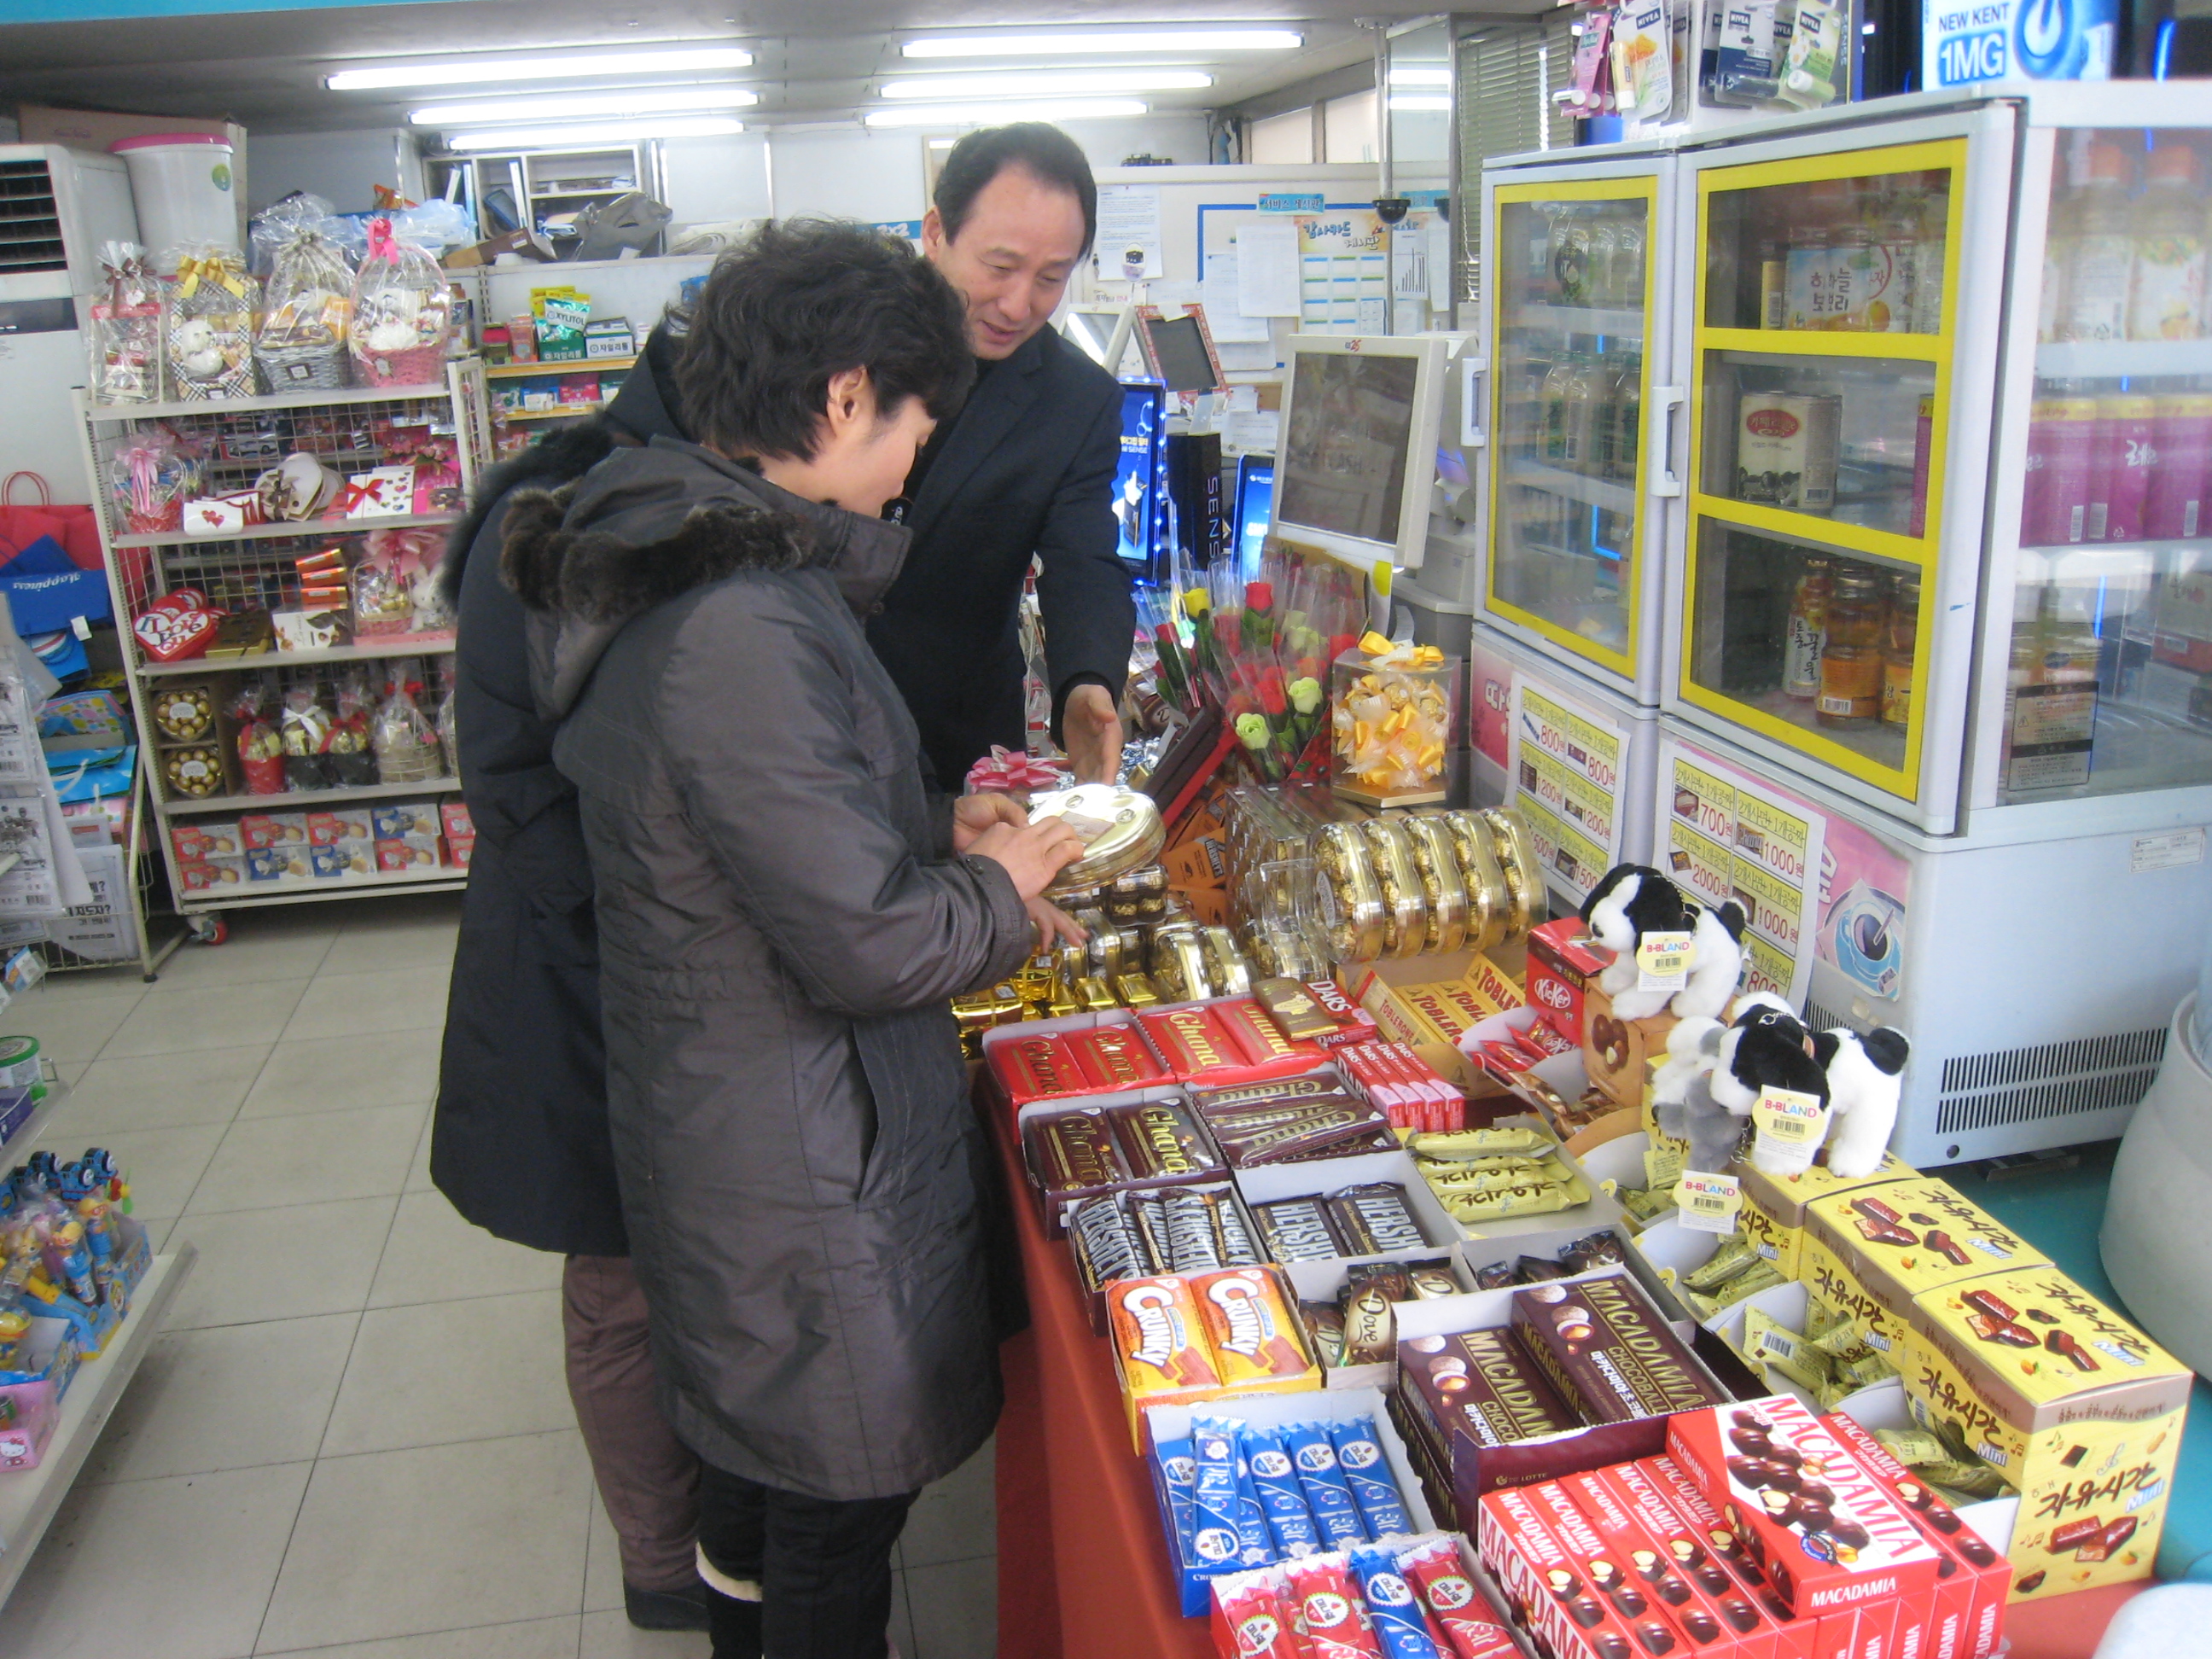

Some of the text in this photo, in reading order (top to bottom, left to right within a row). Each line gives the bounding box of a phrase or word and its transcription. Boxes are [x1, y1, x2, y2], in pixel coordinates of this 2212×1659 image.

[1637, 9, 1661, 28] NIVEA
[1730, 12, 1749, 25] NIVEA
[1800, 14, 1820, 32] NIVEA
[1939, 3, 2010, 32] NEW KENT
[1941, 32, 2004, 82] 1MG
[556, 311, 586, 325] XYLITOL
[599, 342, 629, 352] 자일리톨
[1700, 803, 1733, 837] 700원
[1764, 841, 1804, 879] 1000원
[1692, 864, 1730, 899] 2000원
[1757, 905, 1799, 945] 1000원
[1646, 941, 1691, 953] B-BLAND
[1307, 980, 1353, 1013] DARS
[1379, 998, 1416, 1042] TOBLERONE
[1092, 1030, 1139, 1084] Ghana
[1168, 1013, 1221, 1067] Ghana
[1318, 1033, 1346, 1048] DARS
[1341, 1046, 1361, 1065] DARS
[1358, 1045, 1379, 1063] DARS
[1376, 1044, 1396, 1062] DARS
[1393, 1041, 1414, 1059] DARS
[1022, 1039, 1065, 1095] Ghana
[1217, 1080, 1322, 1104] Ghana
[1765, 1099, 1818, 1118] B-BLAND
[1139, 1107, 1189, 1173] Ghana
[1252, 1109, 1357, 1148] Ghana
[1060, 1115, 1104, 1183] Ghana
[1685, 1180, 1736, 1196] B-BLAND
[1919, 1190, 2018, 1254] 자유시간
[1757, 1243, 1779, 1260] Mini
[1965, 1237, 2013, 1260] Mini
[1208, 1278, 1260, 1357] CRUNKY
[1358, 1293, 1387, 1344] Dove
[1813, 1266, 1888, 1337] 자유시간
[1123, 1285, 1174, 1367] CRUNKY
[1864, 1330, 1891, 1353] Mini
[2034, 1282, 2151, 1364] 자유시간
[1581, 1280, 1707, 1410] MACADAMIA
[2092, 1341, 2145, 1366] Mini
[1747, 1404, 1773, 1427] meiji
[1919, 1365, 2005, 1451] 자유시간
[1831, 1414, 1908, 1480] MACADAMIA
[1976, 1442, 2007, 1467] Mini
[1652, 1456, 1722, 1528] MACADAMIA
[1759, 1397, 1924, 1559] MACADAMIA
[2034, 1461, 2162, 1519] 자유시간
[1538, 1483, 1606, 1557] MACADAMIA
[1580, 1476, 1630, 1531] MACADAMIA
[1615, 1465, 1685, 1538] MACADAMIA
[1498, 1492, 1565, 1568] MACADAMIA
[1810, 1576, 1897, 1608] MACADAMIA
